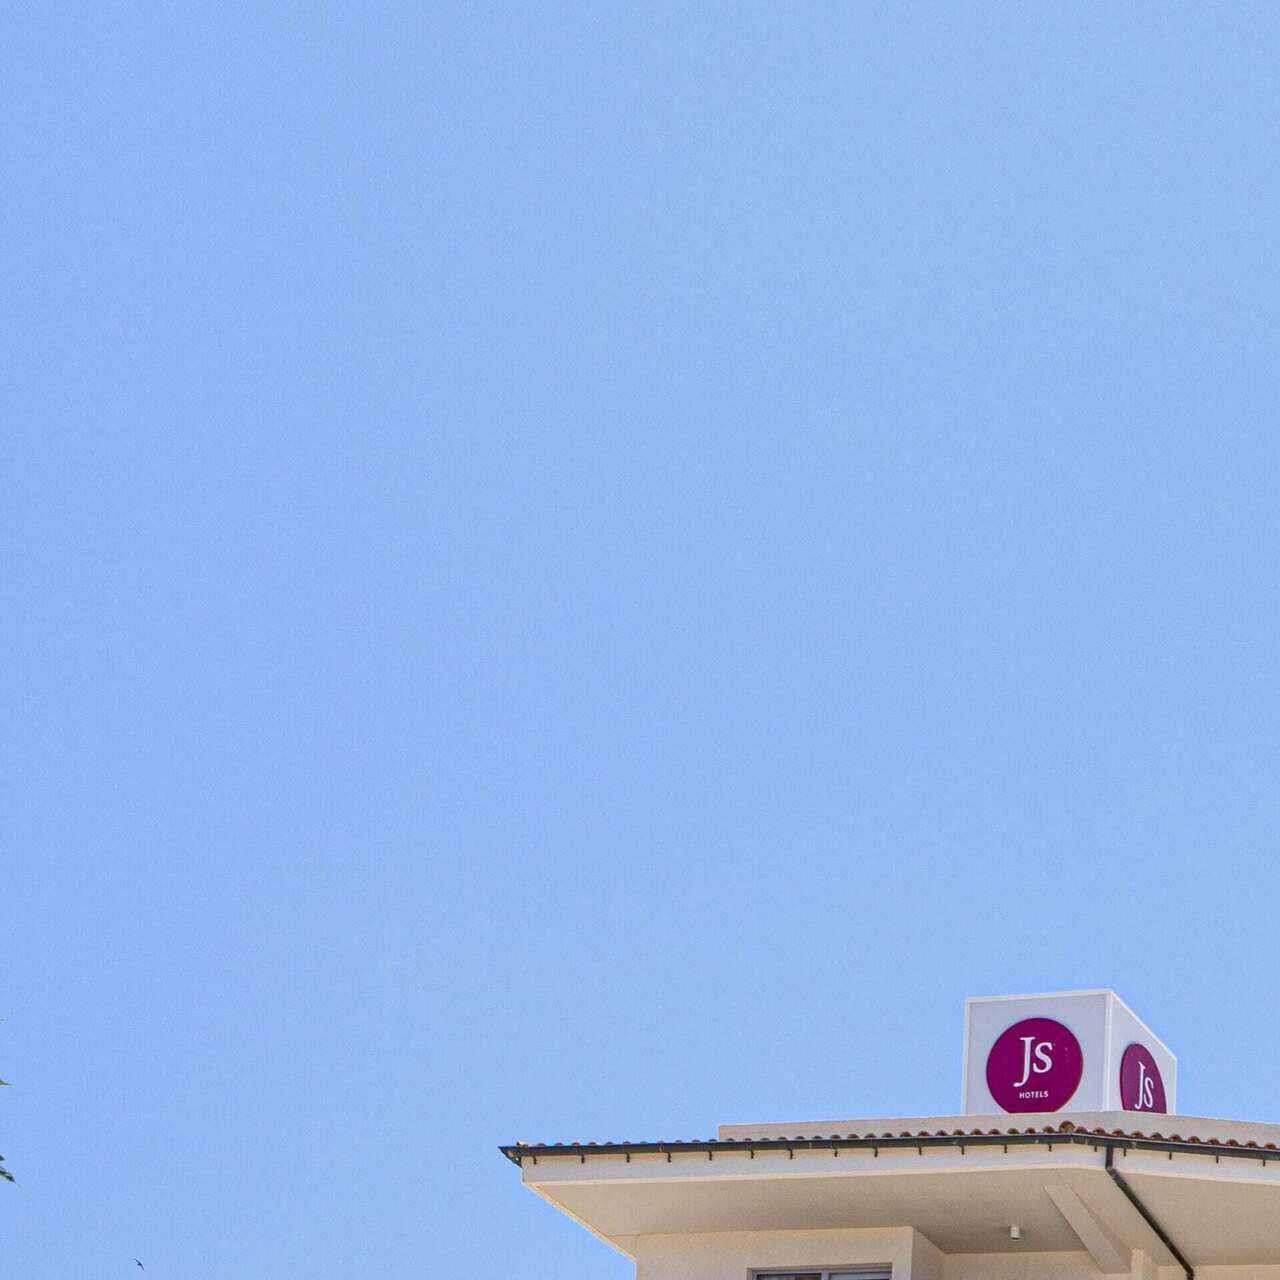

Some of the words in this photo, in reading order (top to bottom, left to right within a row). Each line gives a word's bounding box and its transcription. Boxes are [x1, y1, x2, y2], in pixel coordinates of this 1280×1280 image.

[1013, 1036, 1053, 1087] JS
[1134, 1061, 1154, 1110] JS
[1019, 1090, 1049, 1099] HOTELS
